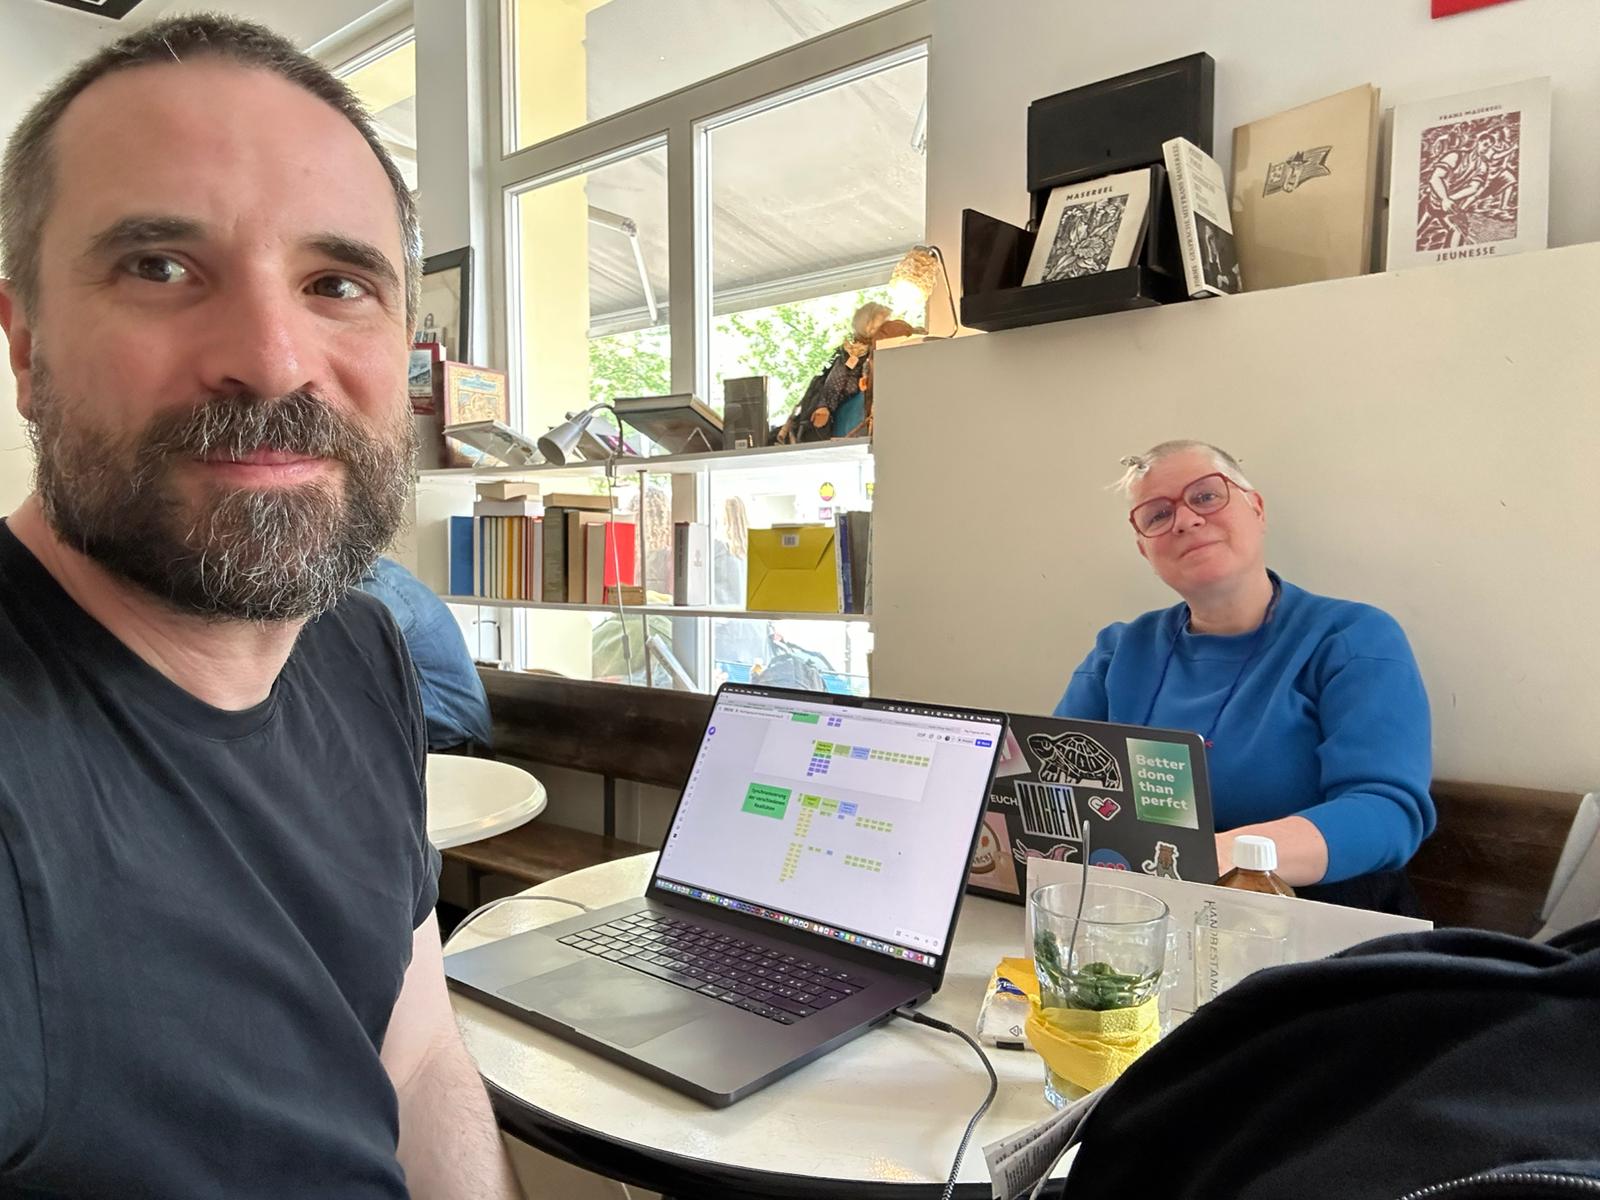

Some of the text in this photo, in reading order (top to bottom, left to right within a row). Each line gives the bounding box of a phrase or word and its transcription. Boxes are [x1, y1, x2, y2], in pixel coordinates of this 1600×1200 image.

[1439, 111, 1462, 121] FRANS
[1066, 186, 1113, 201] MASEREEL
[1436, 246, 1496, 262] JEUNESSE
[1136, 754, 1186, 770] Better
[1138, 768, 1175, 783] done
[1139, 781, 1174, 795] than
[1141, 795, 1189, 810] perfct
[1016, 782, 1080, 839] MACHEN
